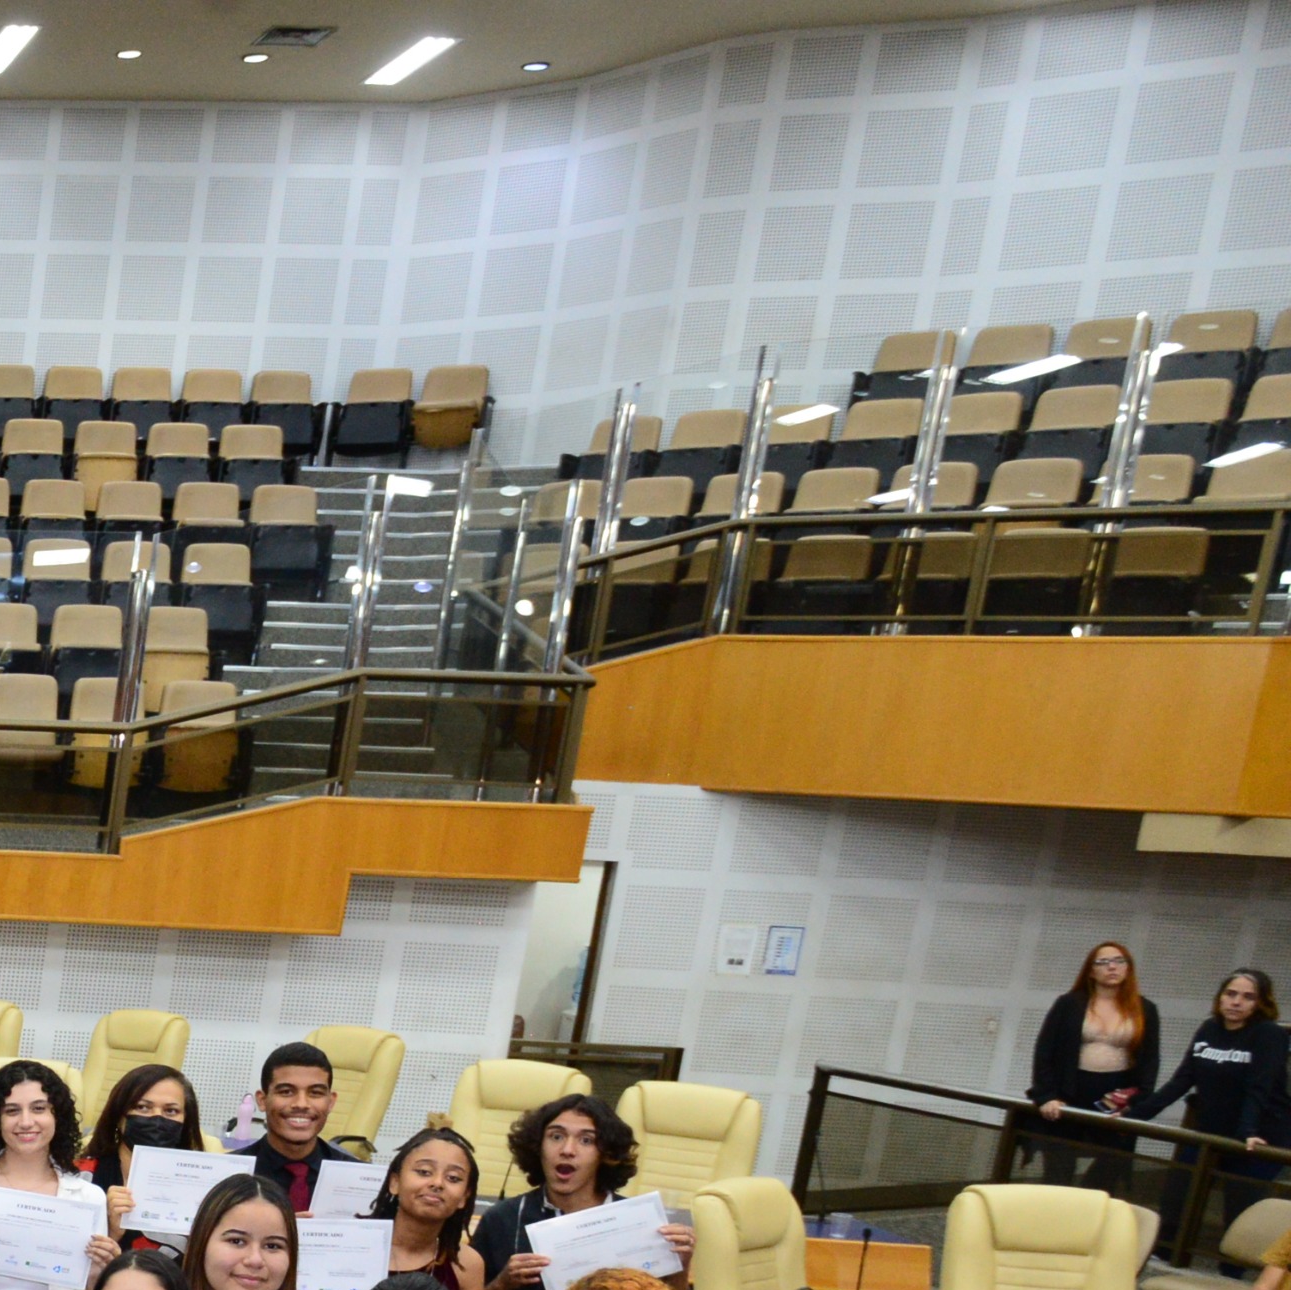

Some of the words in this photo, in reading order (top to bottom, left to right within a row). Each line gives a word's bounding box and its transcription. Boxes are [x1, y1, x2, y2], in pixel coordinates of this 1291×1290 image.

[1192, 1041, 1252, 1064] Compton
[176, 1162, 213, 1170] CERTIFICADO
[16, 1203, 56, 1214] CERTIFICADO
[576, 1216, 617, 1230] CERTIFICADO
